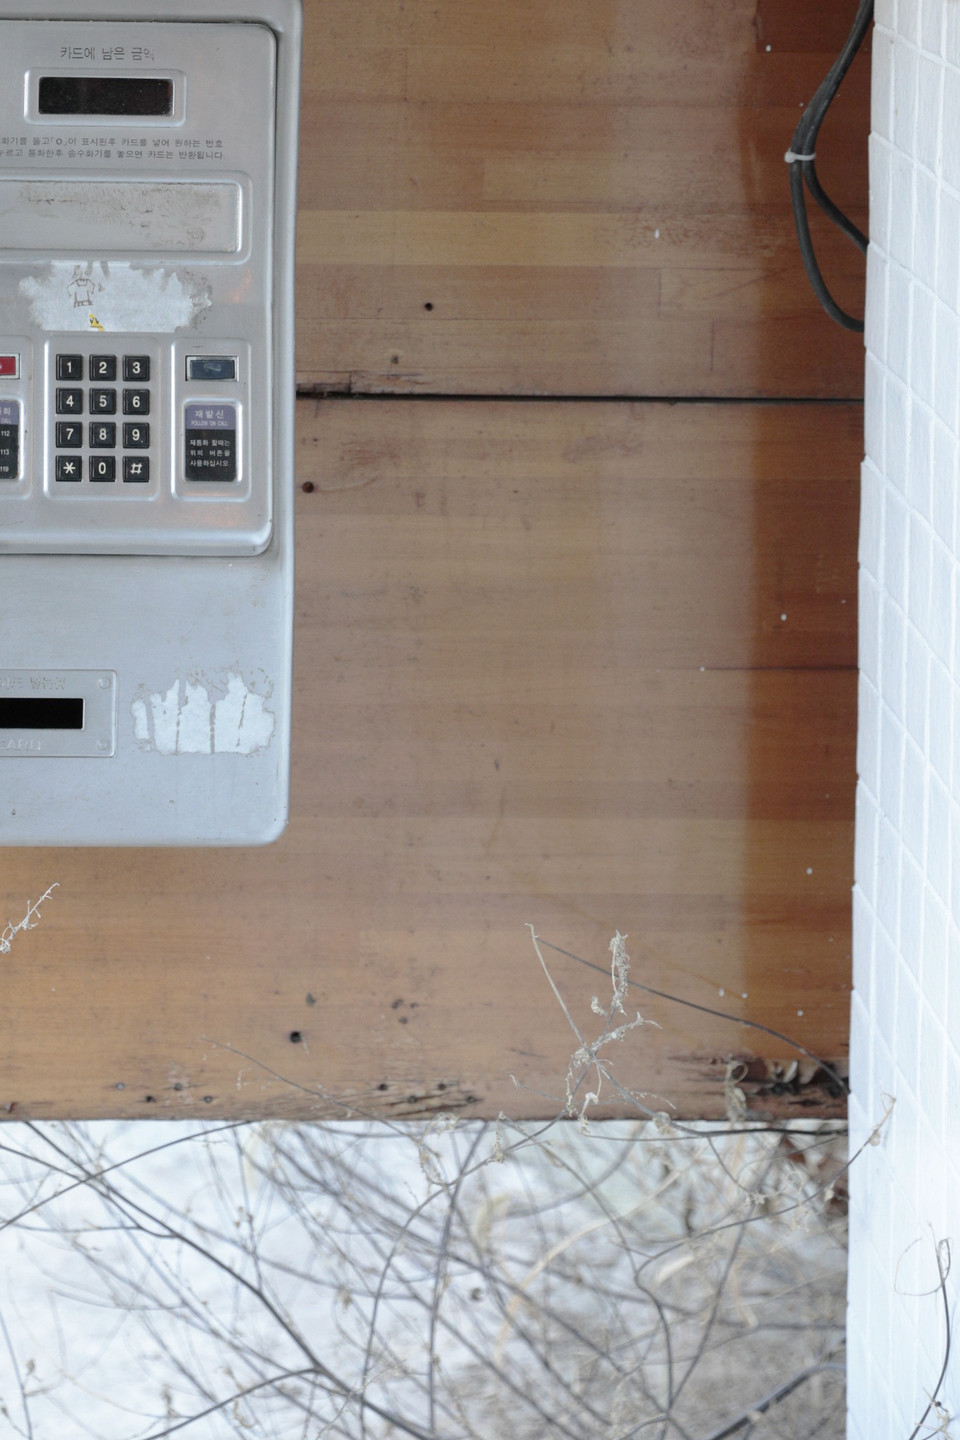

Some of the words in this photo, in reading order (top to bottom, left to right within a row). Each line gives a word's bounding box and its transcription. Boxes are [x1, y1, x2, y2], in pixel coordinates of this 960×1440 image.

[60, 46, 95, 60] 카드에
[101, 46, 125, 61] 남은
[121, 138, 147, 147] 카드를
[152, 138, 170, 148] 넣어
[174, 138, 201, 148] 원하는
[205, 138, 224, 148] 번호
[67, 149, 111, 159] 송수화기를
[116, 150, 143, 159] 놓으면
[148, 150, 174, 159] 카드는
[67, 361, 72, 373] 1
[99, 361, 107, 374] 2
[132, 361, 140, 374] 3
[66, 395, 74, 407] 4
[99, 395, 107, 407] 5
[132, 396, 140, 408] 6
[194, 409, 224, 419] 재발신
[66, 428, 74, 440] 7
[99, 428, 107, 440] 8
[132, 428, 140, 441] 9
[189, 439, 209, 447] 재통화
[98, 462, 107, 474] 0
[189, 459, 229, 467] 사용하십시오
